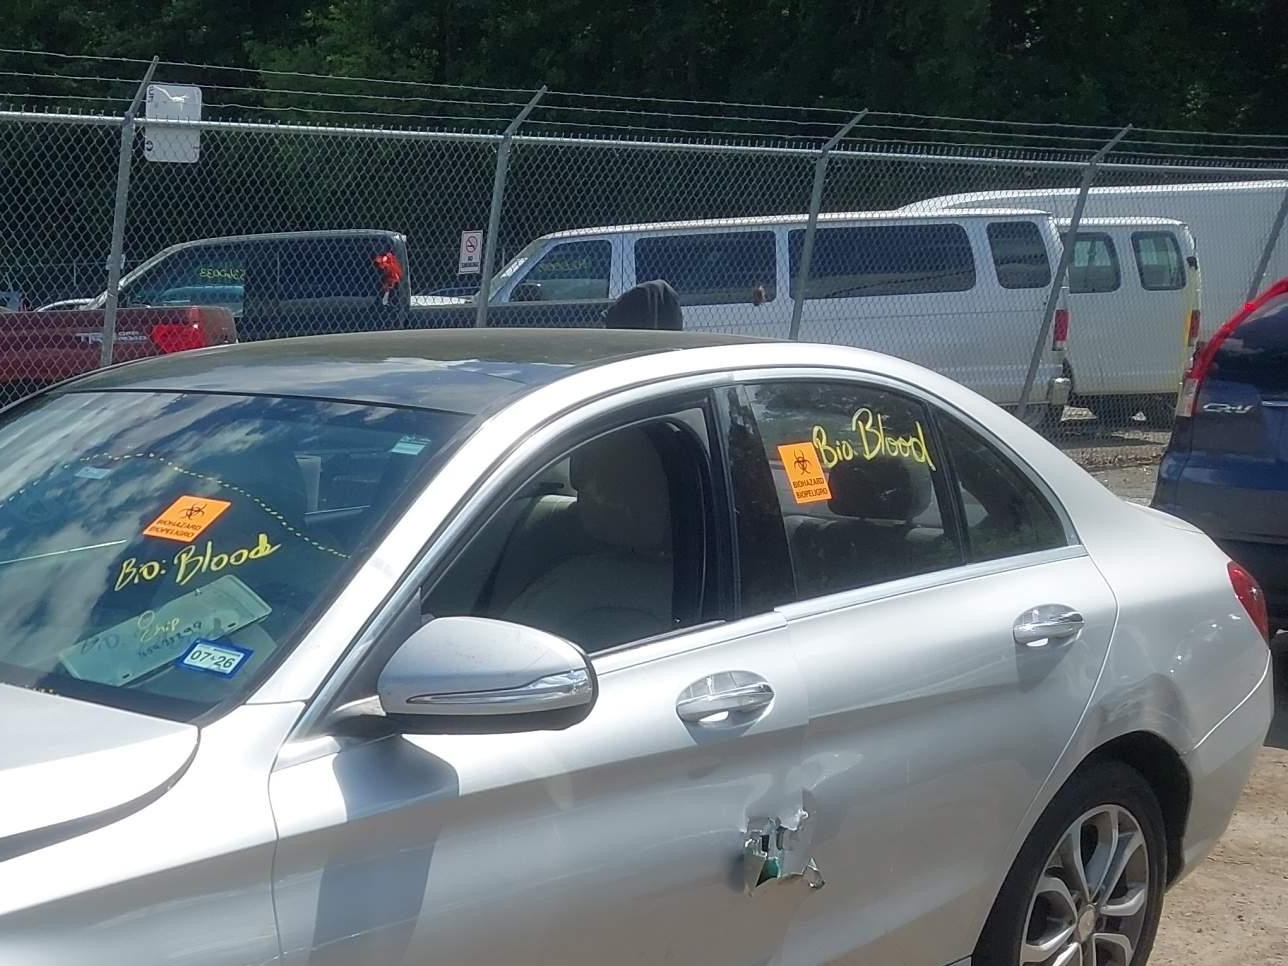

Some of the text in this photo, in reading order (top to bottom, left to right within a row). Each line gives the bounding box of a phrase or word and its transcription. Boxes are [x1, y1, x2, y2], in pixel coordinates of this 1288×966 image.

[852, 407, 937, 472] Blood
[793, 477, 825, 489] BIOHAZARD
[155, 519, 202, 531] BIOHAZARD
[173, 533, 281, 586] Blood
